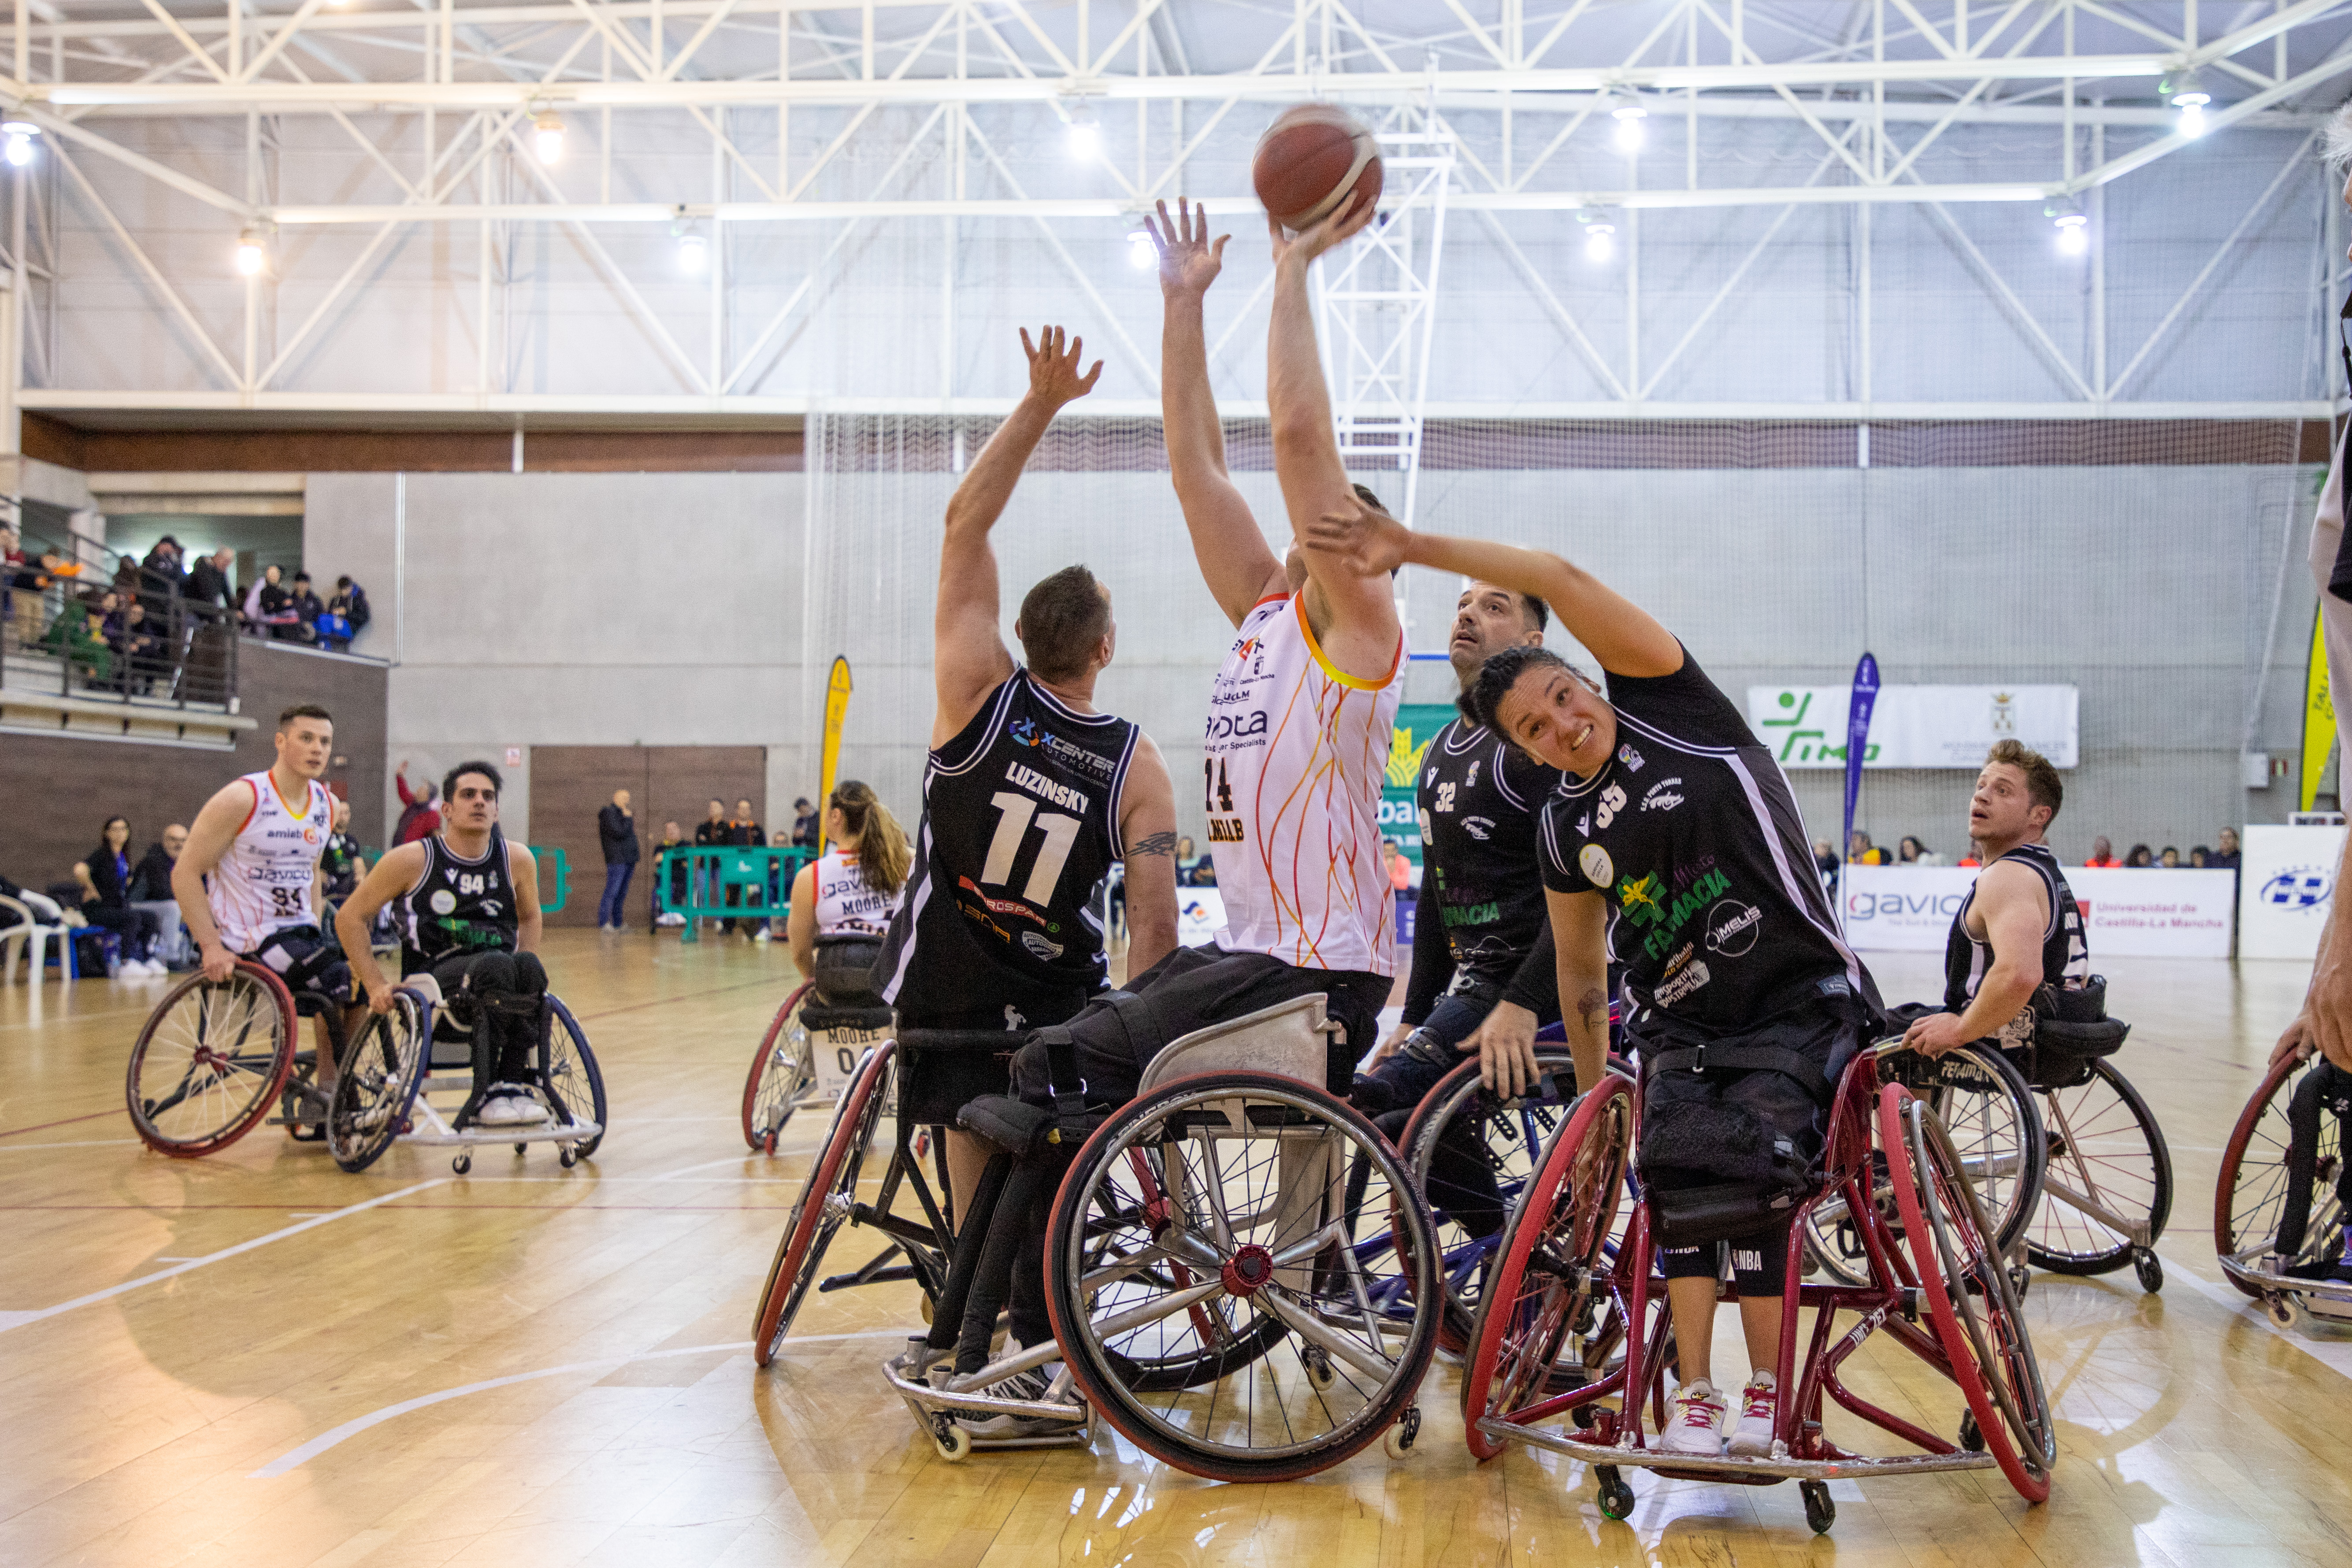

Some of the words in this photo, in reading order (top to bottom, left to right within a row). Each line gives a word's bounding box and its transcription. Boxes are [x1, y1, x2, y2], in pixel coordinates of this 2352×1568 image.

[1224, 690, 1250, 701] UCLM
[1041, 732, 1116, 773] XCENTER
[1230, 738, 1266, 749] Specialists
[1005, 761, 1089, 814] LUZINSKY
[1661, 777, 1682, 788] TORRES
[1435, 782, 1456, 812] 32
[267, 829, 303, 839] amiab
[981, 792, 1082, 908] 11
[459, 873, 485, 896] 94
[842, 890, 891, 916] MOORE
[974, 886, 1046, 926] ROSPAR
[2096, 903, 2178, 913] Universidad
[2181, 903, 2197, 913] de
[1719, 905, 1761, 940] MELIS
[2170, 917, 2224, 927] Mancha
[828, 1027, 880, 1044] MOORE
[1738, 1249, 1762, 1271] NBA
